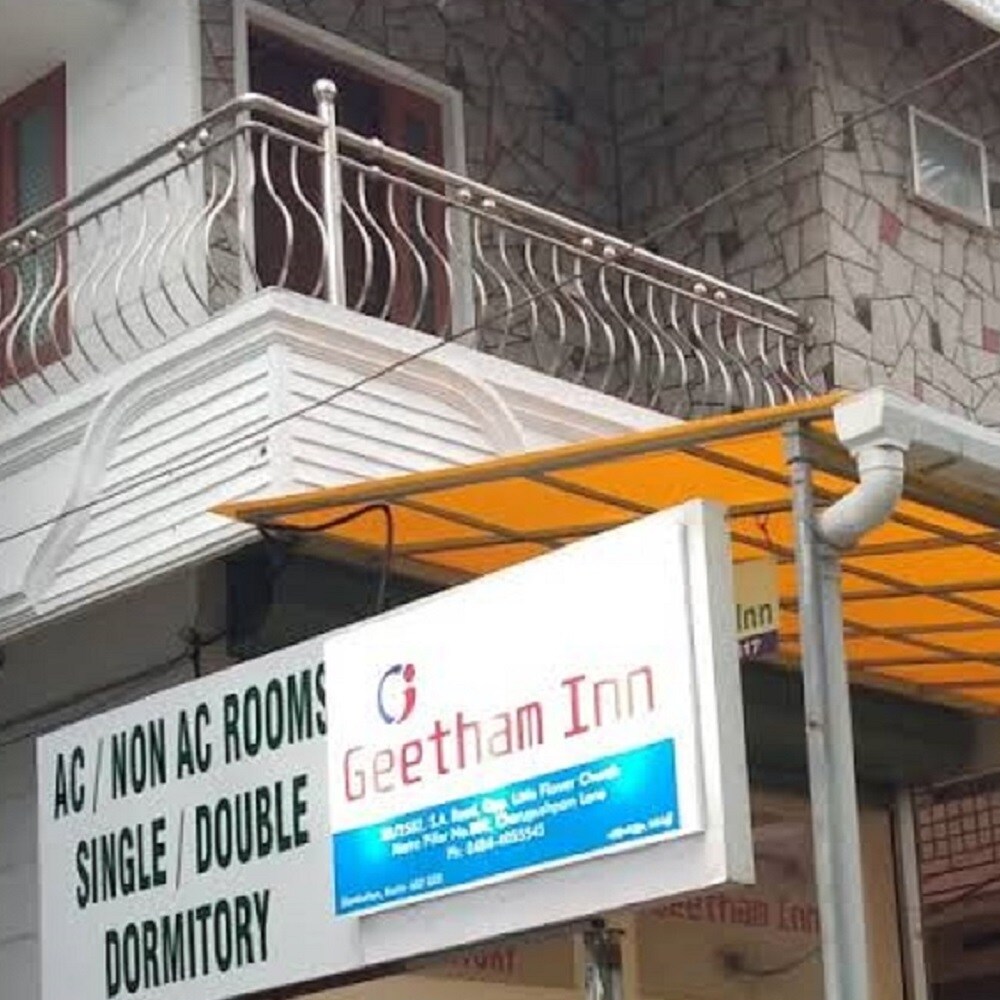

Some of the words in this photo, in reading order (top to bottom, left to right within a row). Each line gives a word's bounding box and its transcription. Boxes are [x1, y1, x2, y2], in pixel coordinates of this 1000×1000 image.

[736, 603, 773, 633] Inn
[54, 745, 85, 819] AC
[93, 737, 104, 813] /
[112, 718, 167, 800] NON
[177, 702, 212, 779] AC
[223, 662, 327, 764] ROOMS
[343, 701, 544, 802] Geetham
[561, 665, 655, 738] Inn
[76, 818, 167, 909] SINGLE
[175, 809, 184, 891] /
[196, 774, 309, 874] DOUBLE
[105, 888, 270, 1000] DORMITORY
